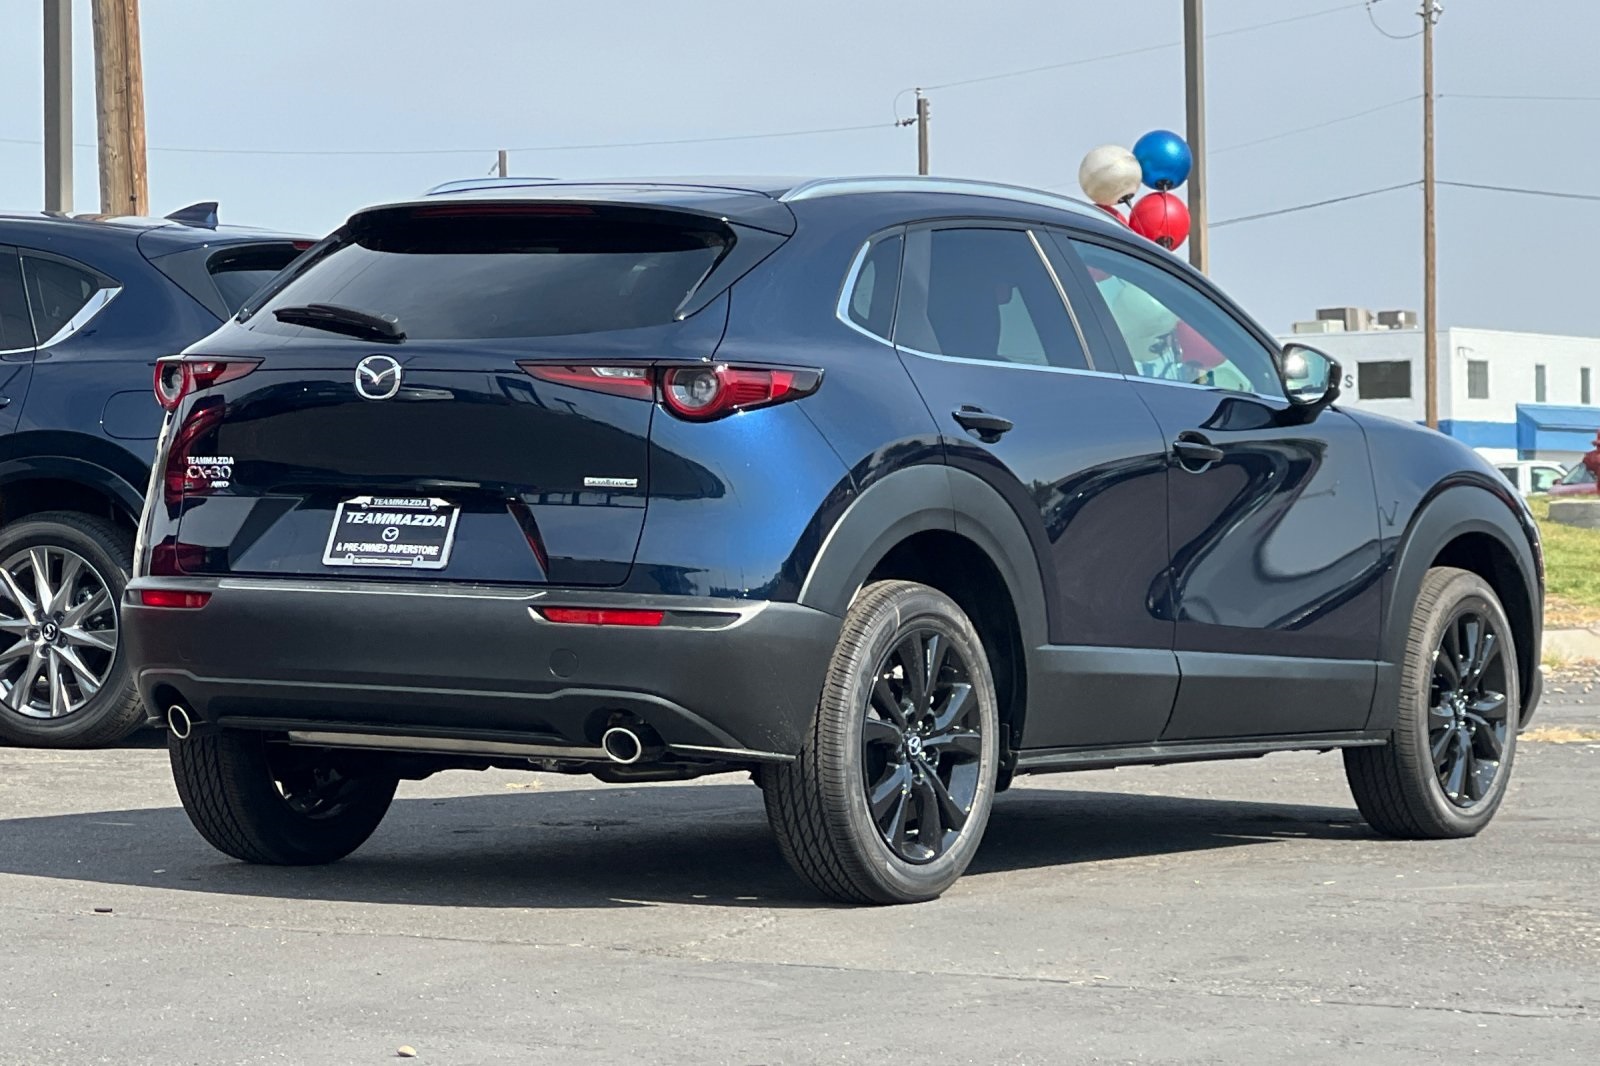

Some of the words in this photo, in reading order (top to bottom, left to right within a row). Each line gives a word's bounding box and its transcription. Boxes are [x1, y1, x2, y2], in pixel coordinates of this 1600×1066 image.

[187, 456, 234, 464] TEAMMAZDA
[186, 465, 231, 479] CX-30
[346, 511, 447, 527] TEAMMAZDA
[336, 542, 342, 552] &
[343, 543, 387, 553] PRE-OWNED
[388, 544, 440, 556] SUPERSTORE
